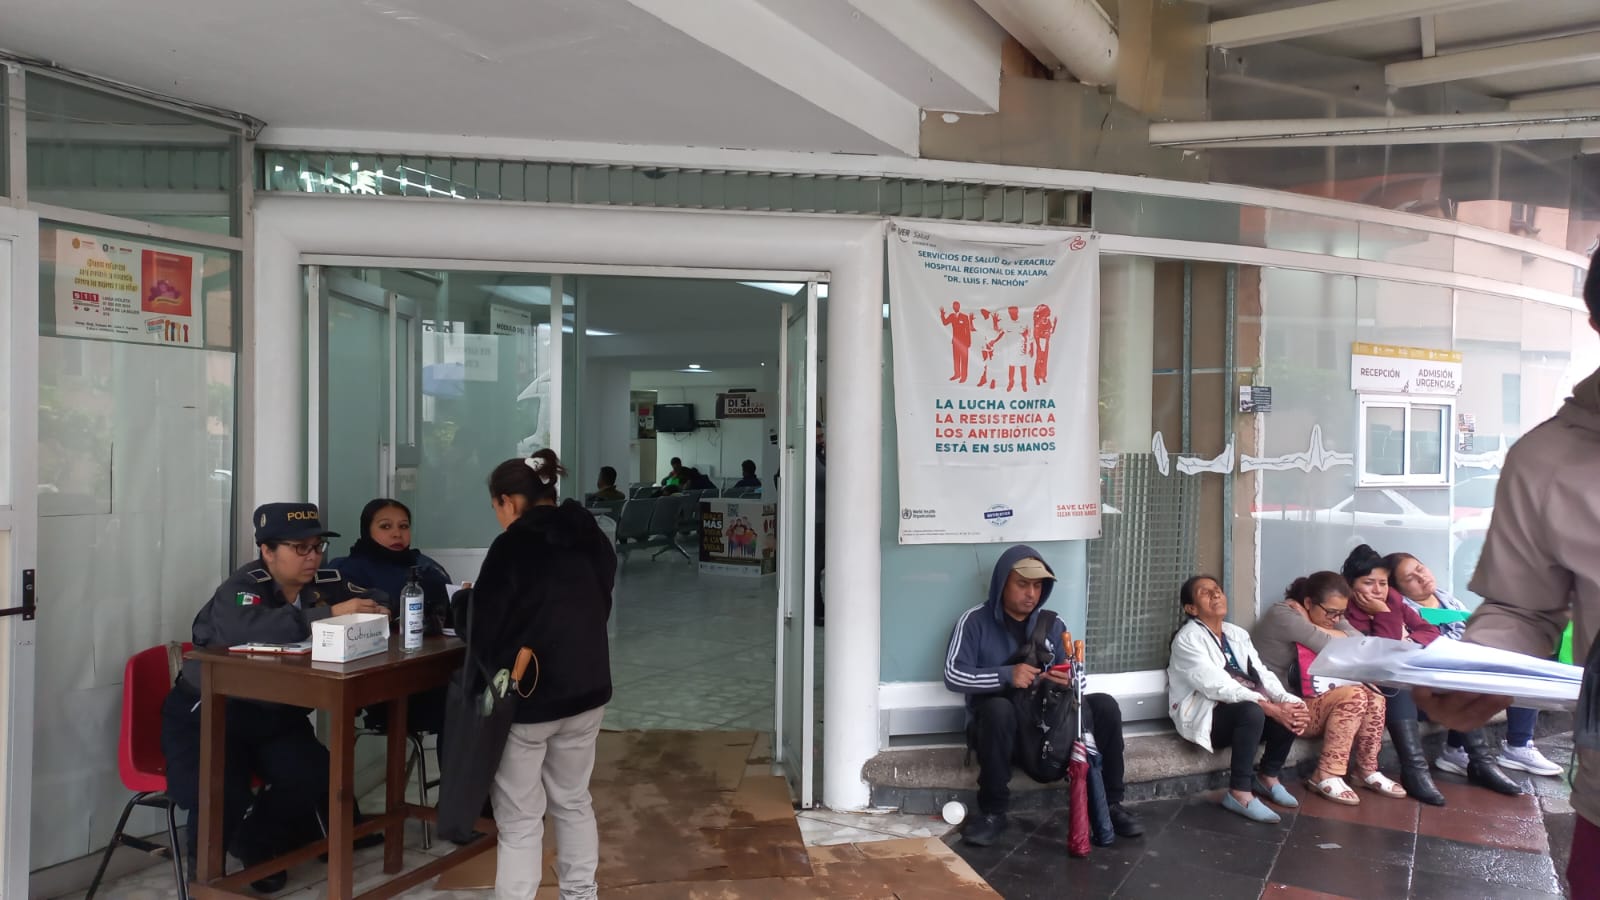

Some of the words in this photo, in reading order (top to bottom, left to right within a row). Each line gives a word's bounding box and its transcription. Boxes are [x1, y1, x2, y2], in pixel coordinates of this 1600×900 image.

[917, 249, 959, 262] SERVICIOS
[961, 254, 973, 263] DE
[974, 255, 1000, 264] SALUD
[924, 261, 962, 273] HOSPITAL
[963, 266, 1004, 275] REGIONAL
[1004, 268, 1016, 276] DE
[1017, 269, 1048, 277] XALAPA
[962, 276, 981, 285] LUIS
[1360, 367, 1401, 378] RECEPCIÓN
[1418, 367, 1453, 380] ADMISIÓN
[1415, 377, 1456, 390] URGENCIAS
[728, 399, 738, 408] DI
[935, 398, 954, 410] LA
[958, 398, 1006, 410] LUCHA
[1009, 398, 1056, 410] CONTRA
[935, 413, 954, 424] LA
[959, 413, 1043, 425] RESISTENCIA
[1047, 412, 1056, 423] A
[935, 427, 963, 438] LOS
[967, 425, 1056, 439] ANTIBIÓTICOS
[935, 441, 968, 453] ESTÁ
[972, 443, 990, 453] EN
[993, 442, 1014, 453] SUS
[1016, 441, 1056, 452] MANOS
